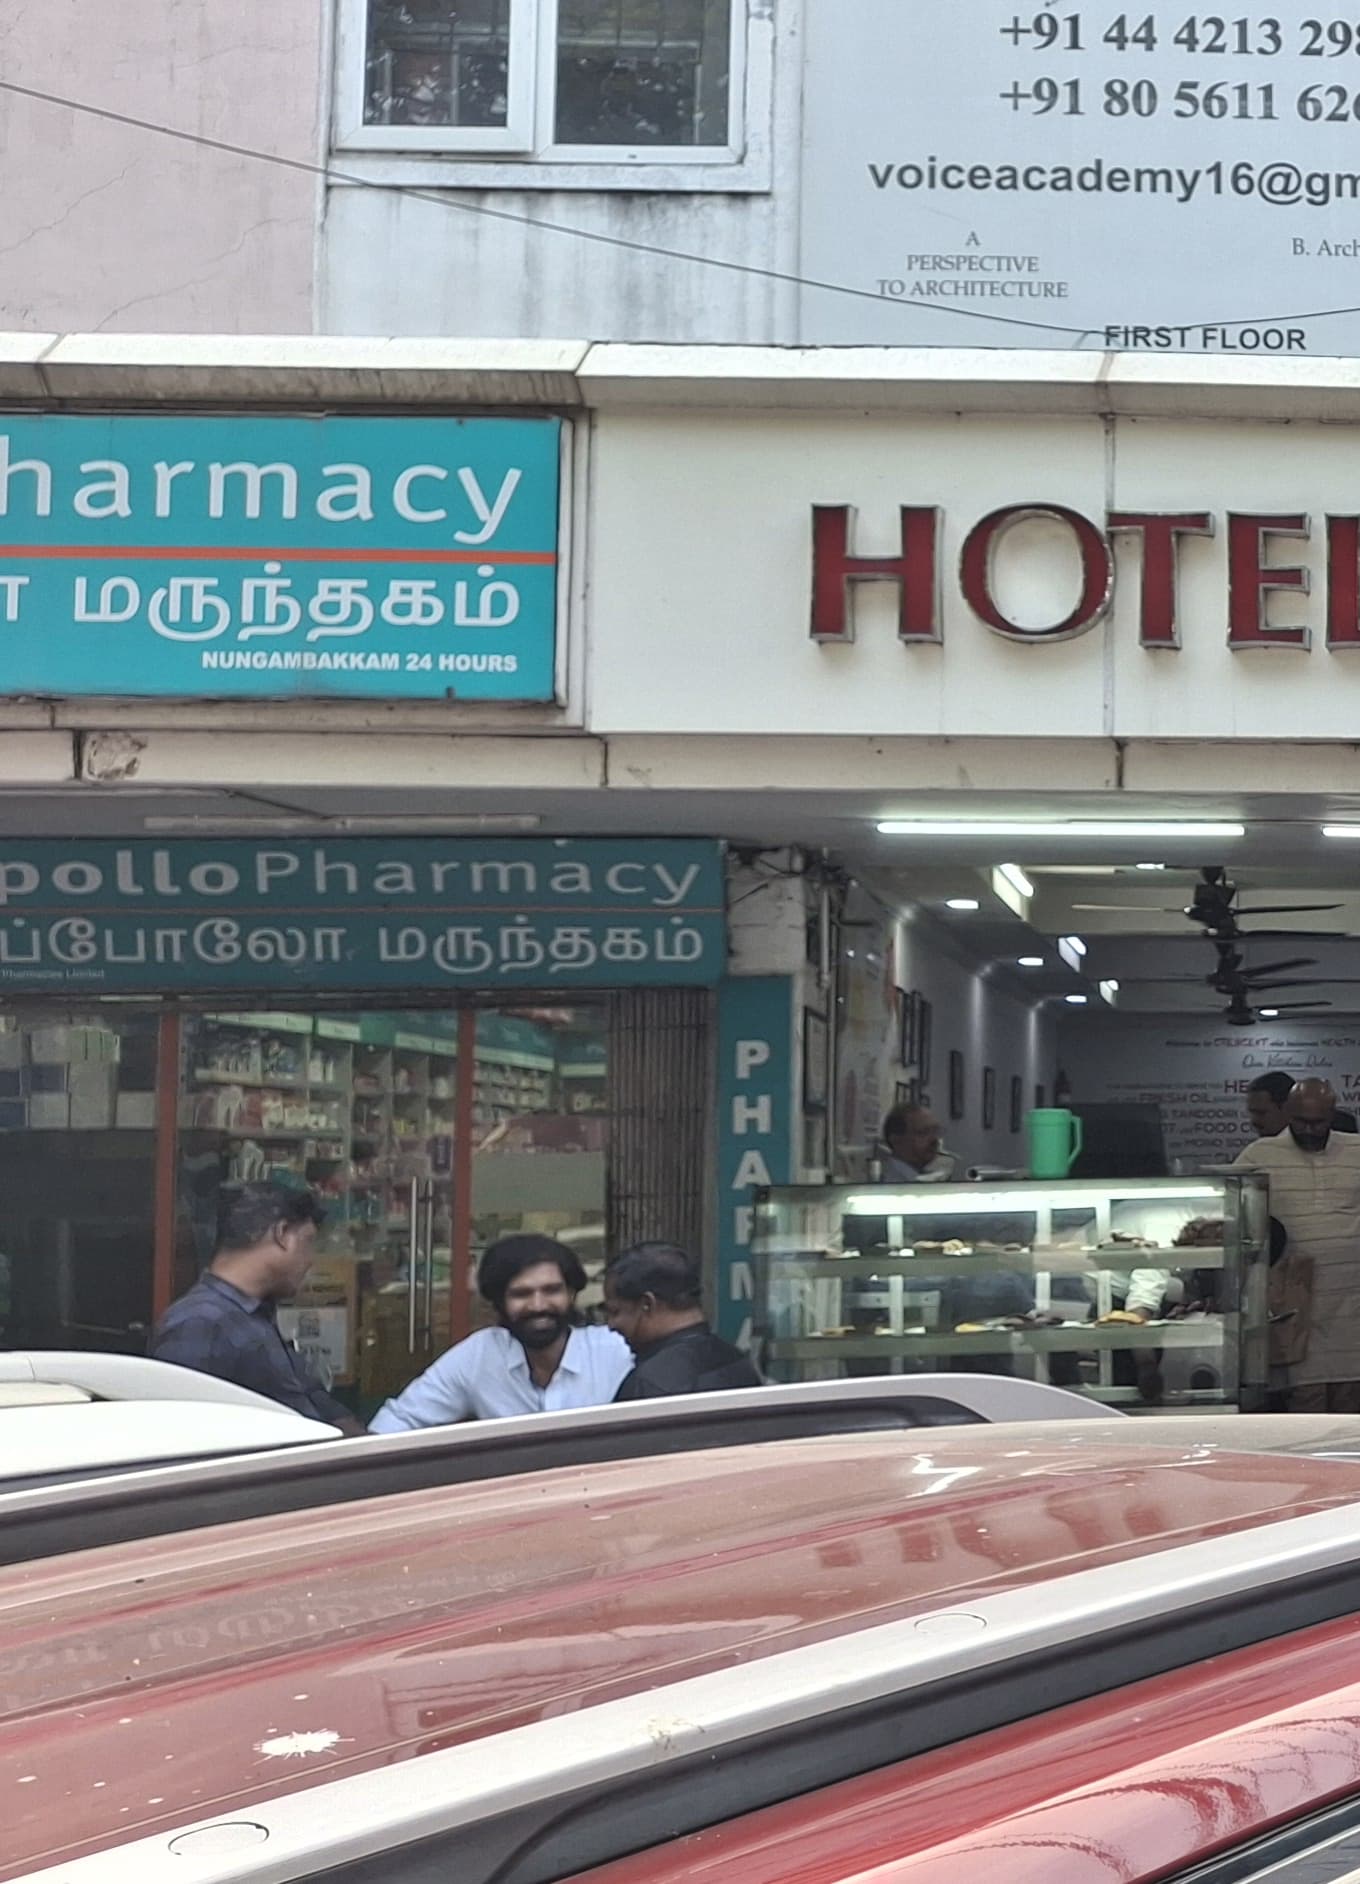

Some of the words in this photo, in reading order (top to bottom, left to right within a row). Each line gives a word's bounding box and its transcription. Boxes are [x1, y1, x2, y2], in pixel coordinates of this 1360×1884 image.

[1000, 12, 1085, 52] +91
[1103, 15, 1157, 53] 44
[1173, 16, 1282, 56] 4213
[1000, 78, 1085, 117] +91
[1103, 79, 1157, 119] 80
[1173, 81, 1280, 122] 5611
[966, 231, 981, 247] A
[906, 253, 1039, 273] PERSPECTIVE
[877, 279, 906, 297] TO
[909, 279, 1069, 299] ARCHITECTURE
[1104, 325, 1192, 349] FIRST
[1202, 326, 1307, 351] FLOOR
[0, 434, 522, 545] harmacy
[74, 562, 520, 642] மருந்தகம்
[201, 651, 400, 672] NUNGAMBAKKAM
[405, 653, 433, 673] 24
[438, 654, 518, 675] HOURS
[0, 917, 347, 963] ப்போலோ
[379, 915, 705, 974] மருந்தகம்
